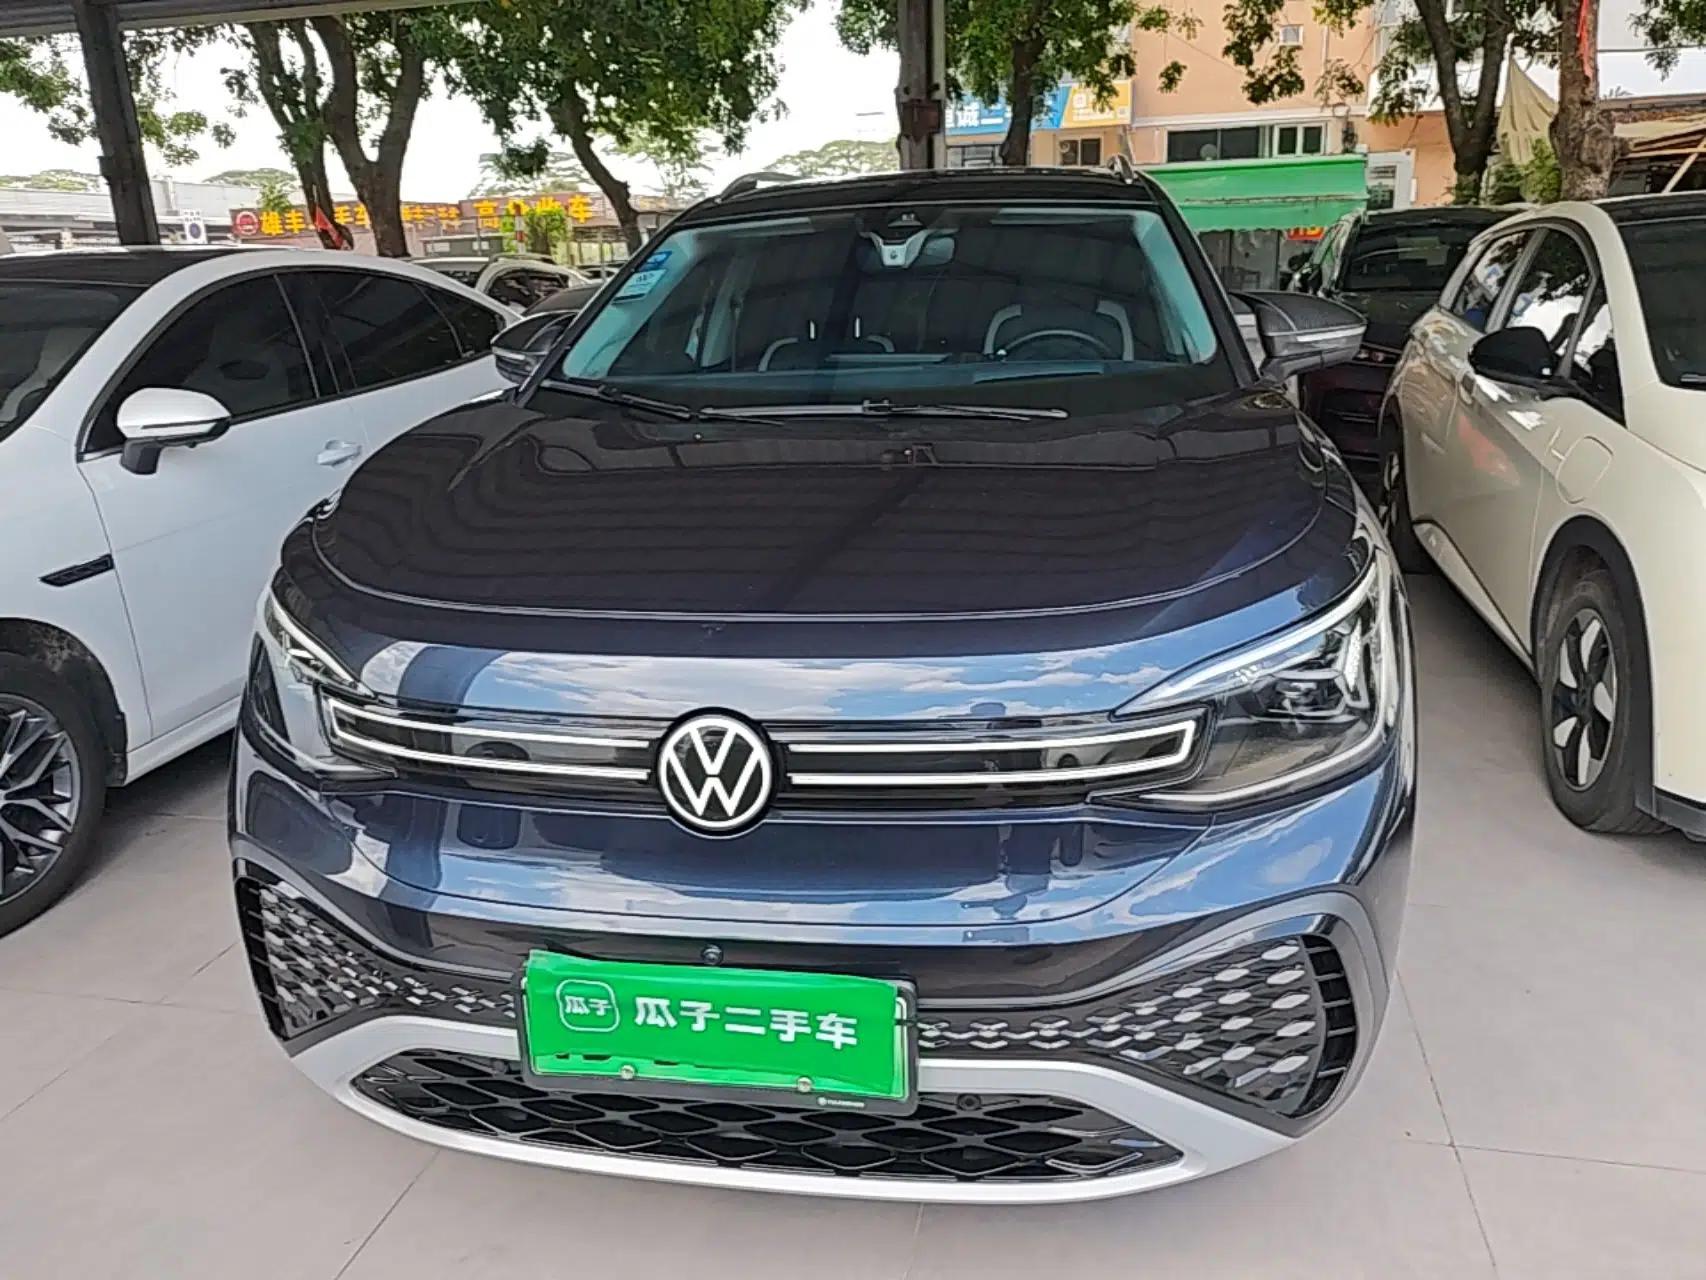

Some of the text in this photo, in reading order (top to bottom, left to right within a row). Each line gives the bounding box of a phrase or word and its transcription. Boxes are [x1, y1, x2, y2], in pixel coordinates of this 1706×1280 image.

[564, 995, 611, 1016] 瓜子
[634, 996, 858, 1050] 瓜子二手车
